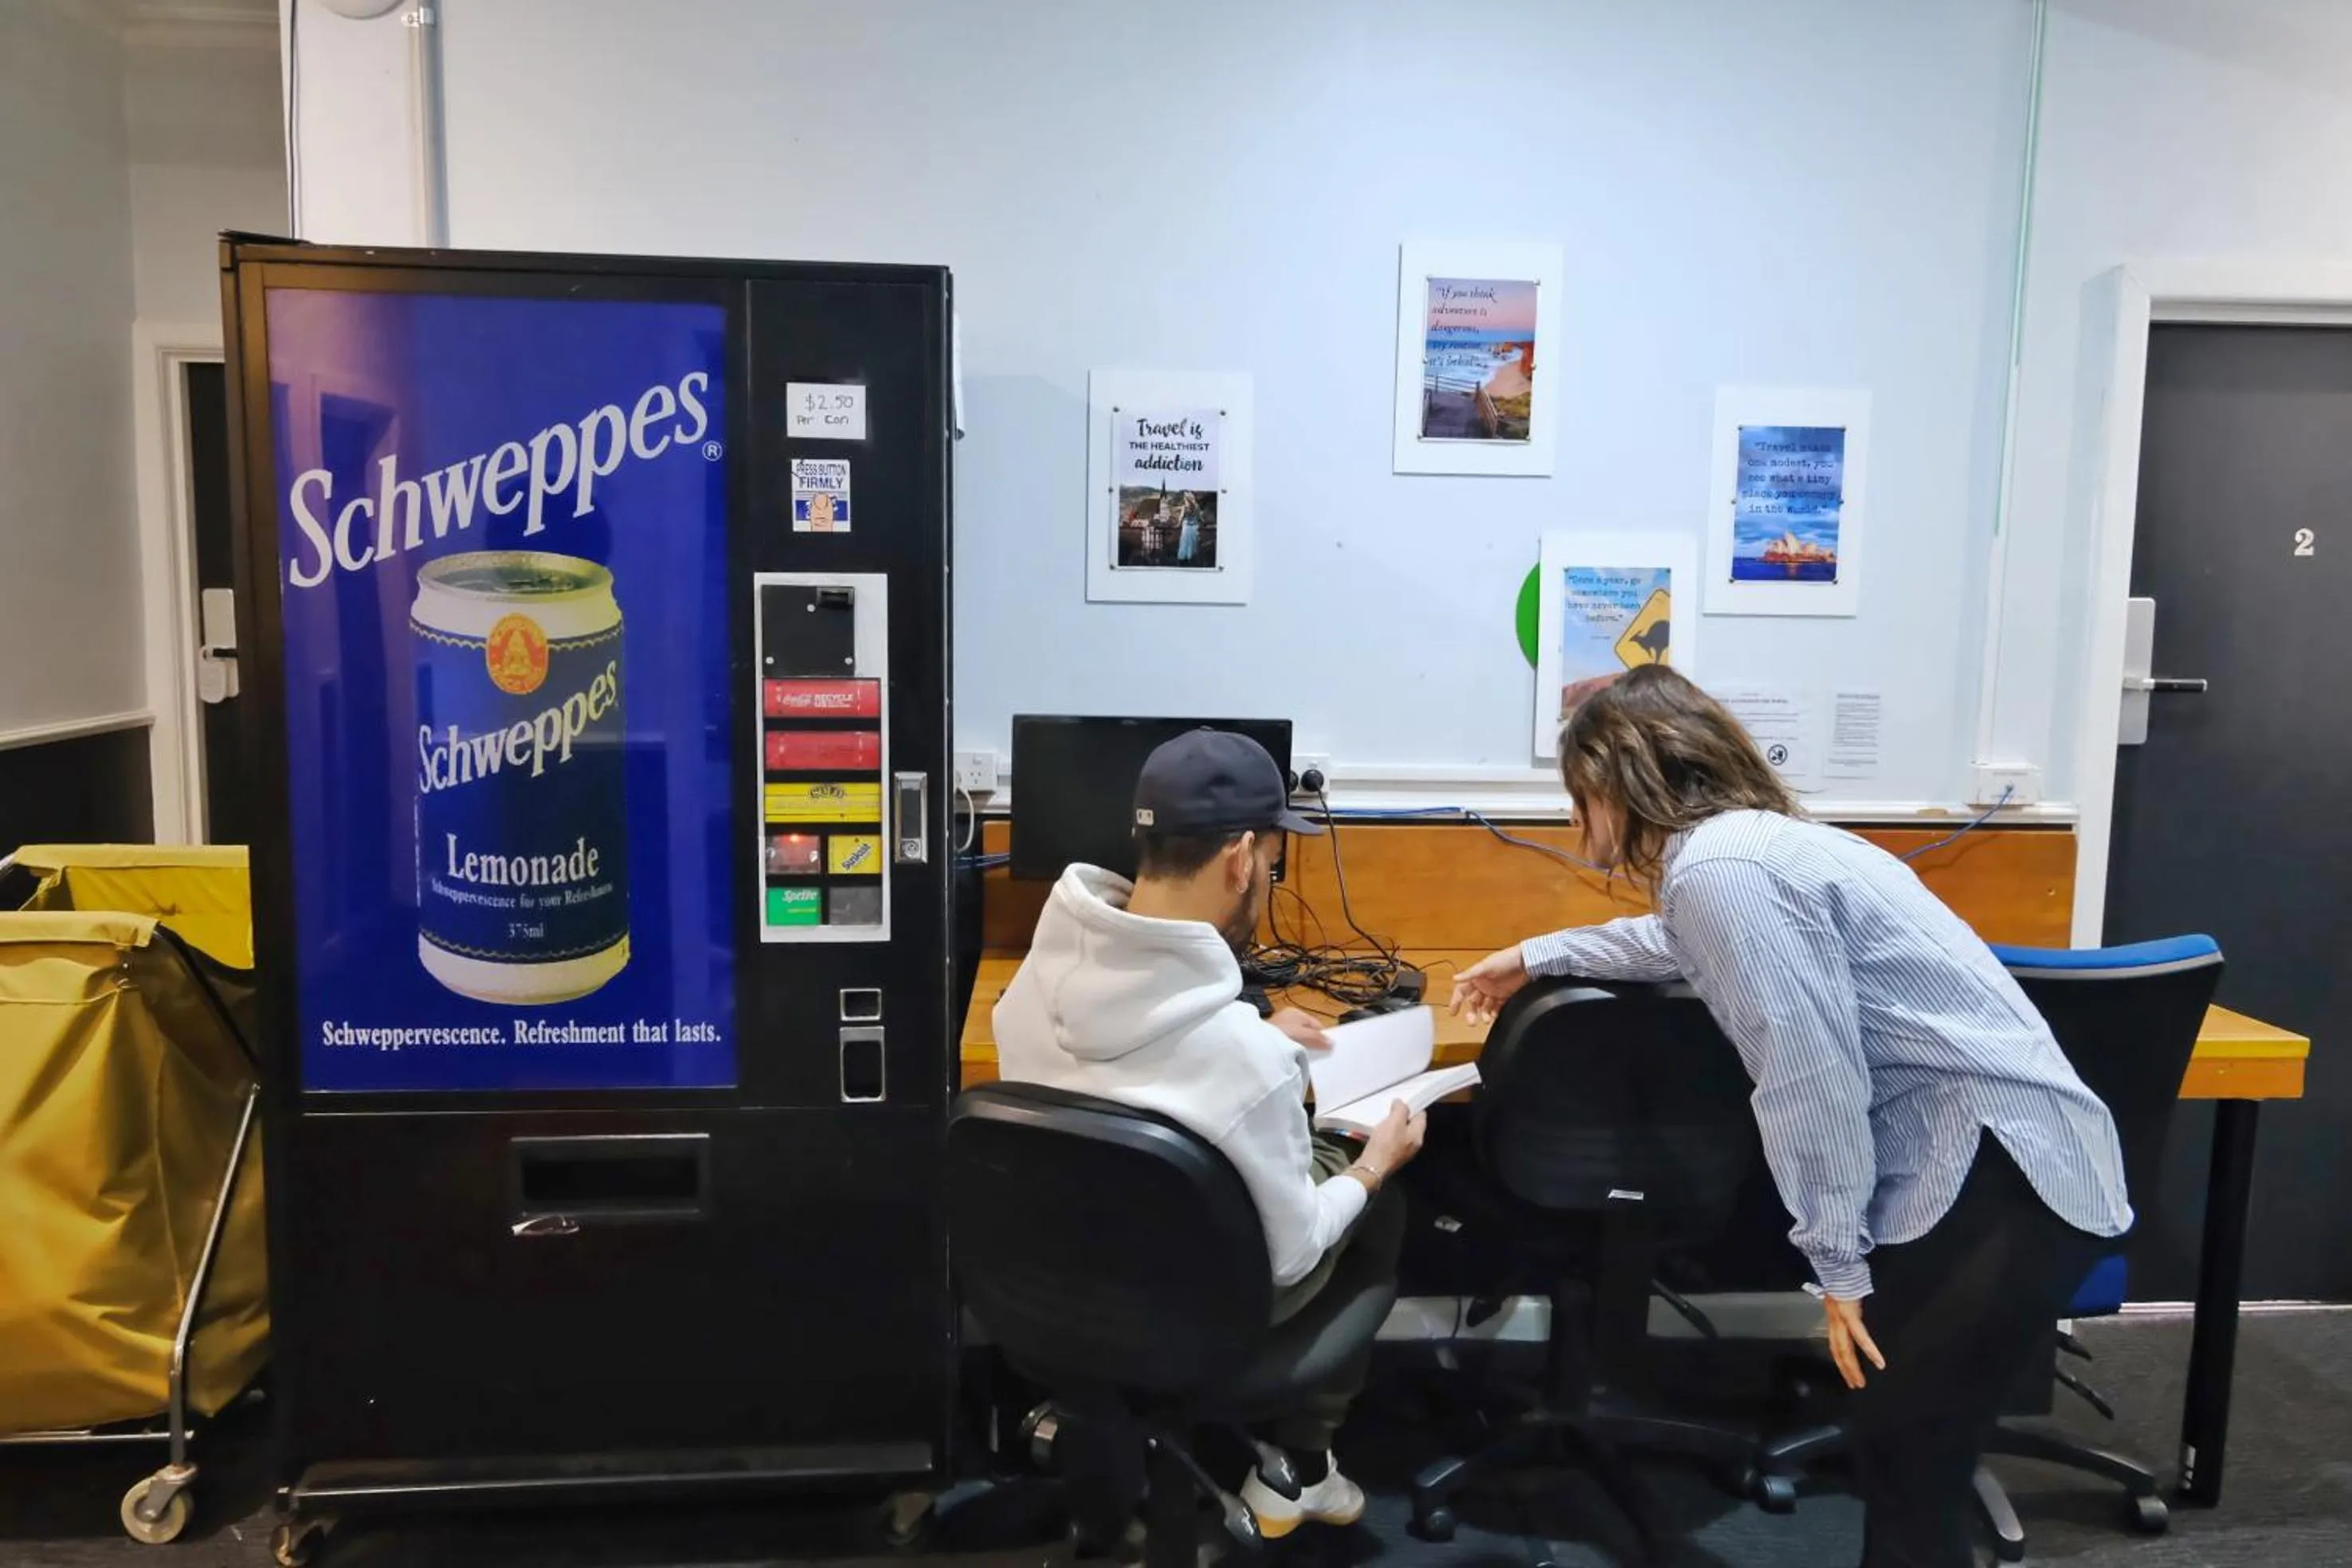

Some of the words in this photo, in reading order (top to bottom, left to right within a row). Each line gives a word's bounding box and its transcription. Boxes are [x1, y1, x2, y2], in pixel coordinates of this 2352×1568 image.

[805, 393, 854, 413] $2.50
[1137, 417, 1187, 437] Travel
[1190, 421, 1205, 440] is
[1129, 441, 1148, 450] THE
[1151, 441, 1210, 452] HEALTHIEST
[797, 464, 817, 476] PRESS
[819, 464, 846, 476] BUTTON
[1135, 453, 1204, 472] addiction
[289, 371, 708, 588] Schweppes
[799, 476, 844, 489] FIRMLY
[2294, 527, 2315, 556] 2
[419, 660, 617, 794] Schweppes
[446, 833, 599, 886] Lemonade
[519, 893, 535, 908] for
[782, 890, 818, 903] Sprite
[322, 1020, 506, 1051] Schweppervescence.
[513, 1020, 625, 1044] Refreshment
[632, 1018, 668, 1042] that
[674, 1018, 721, 1042] lasts.
